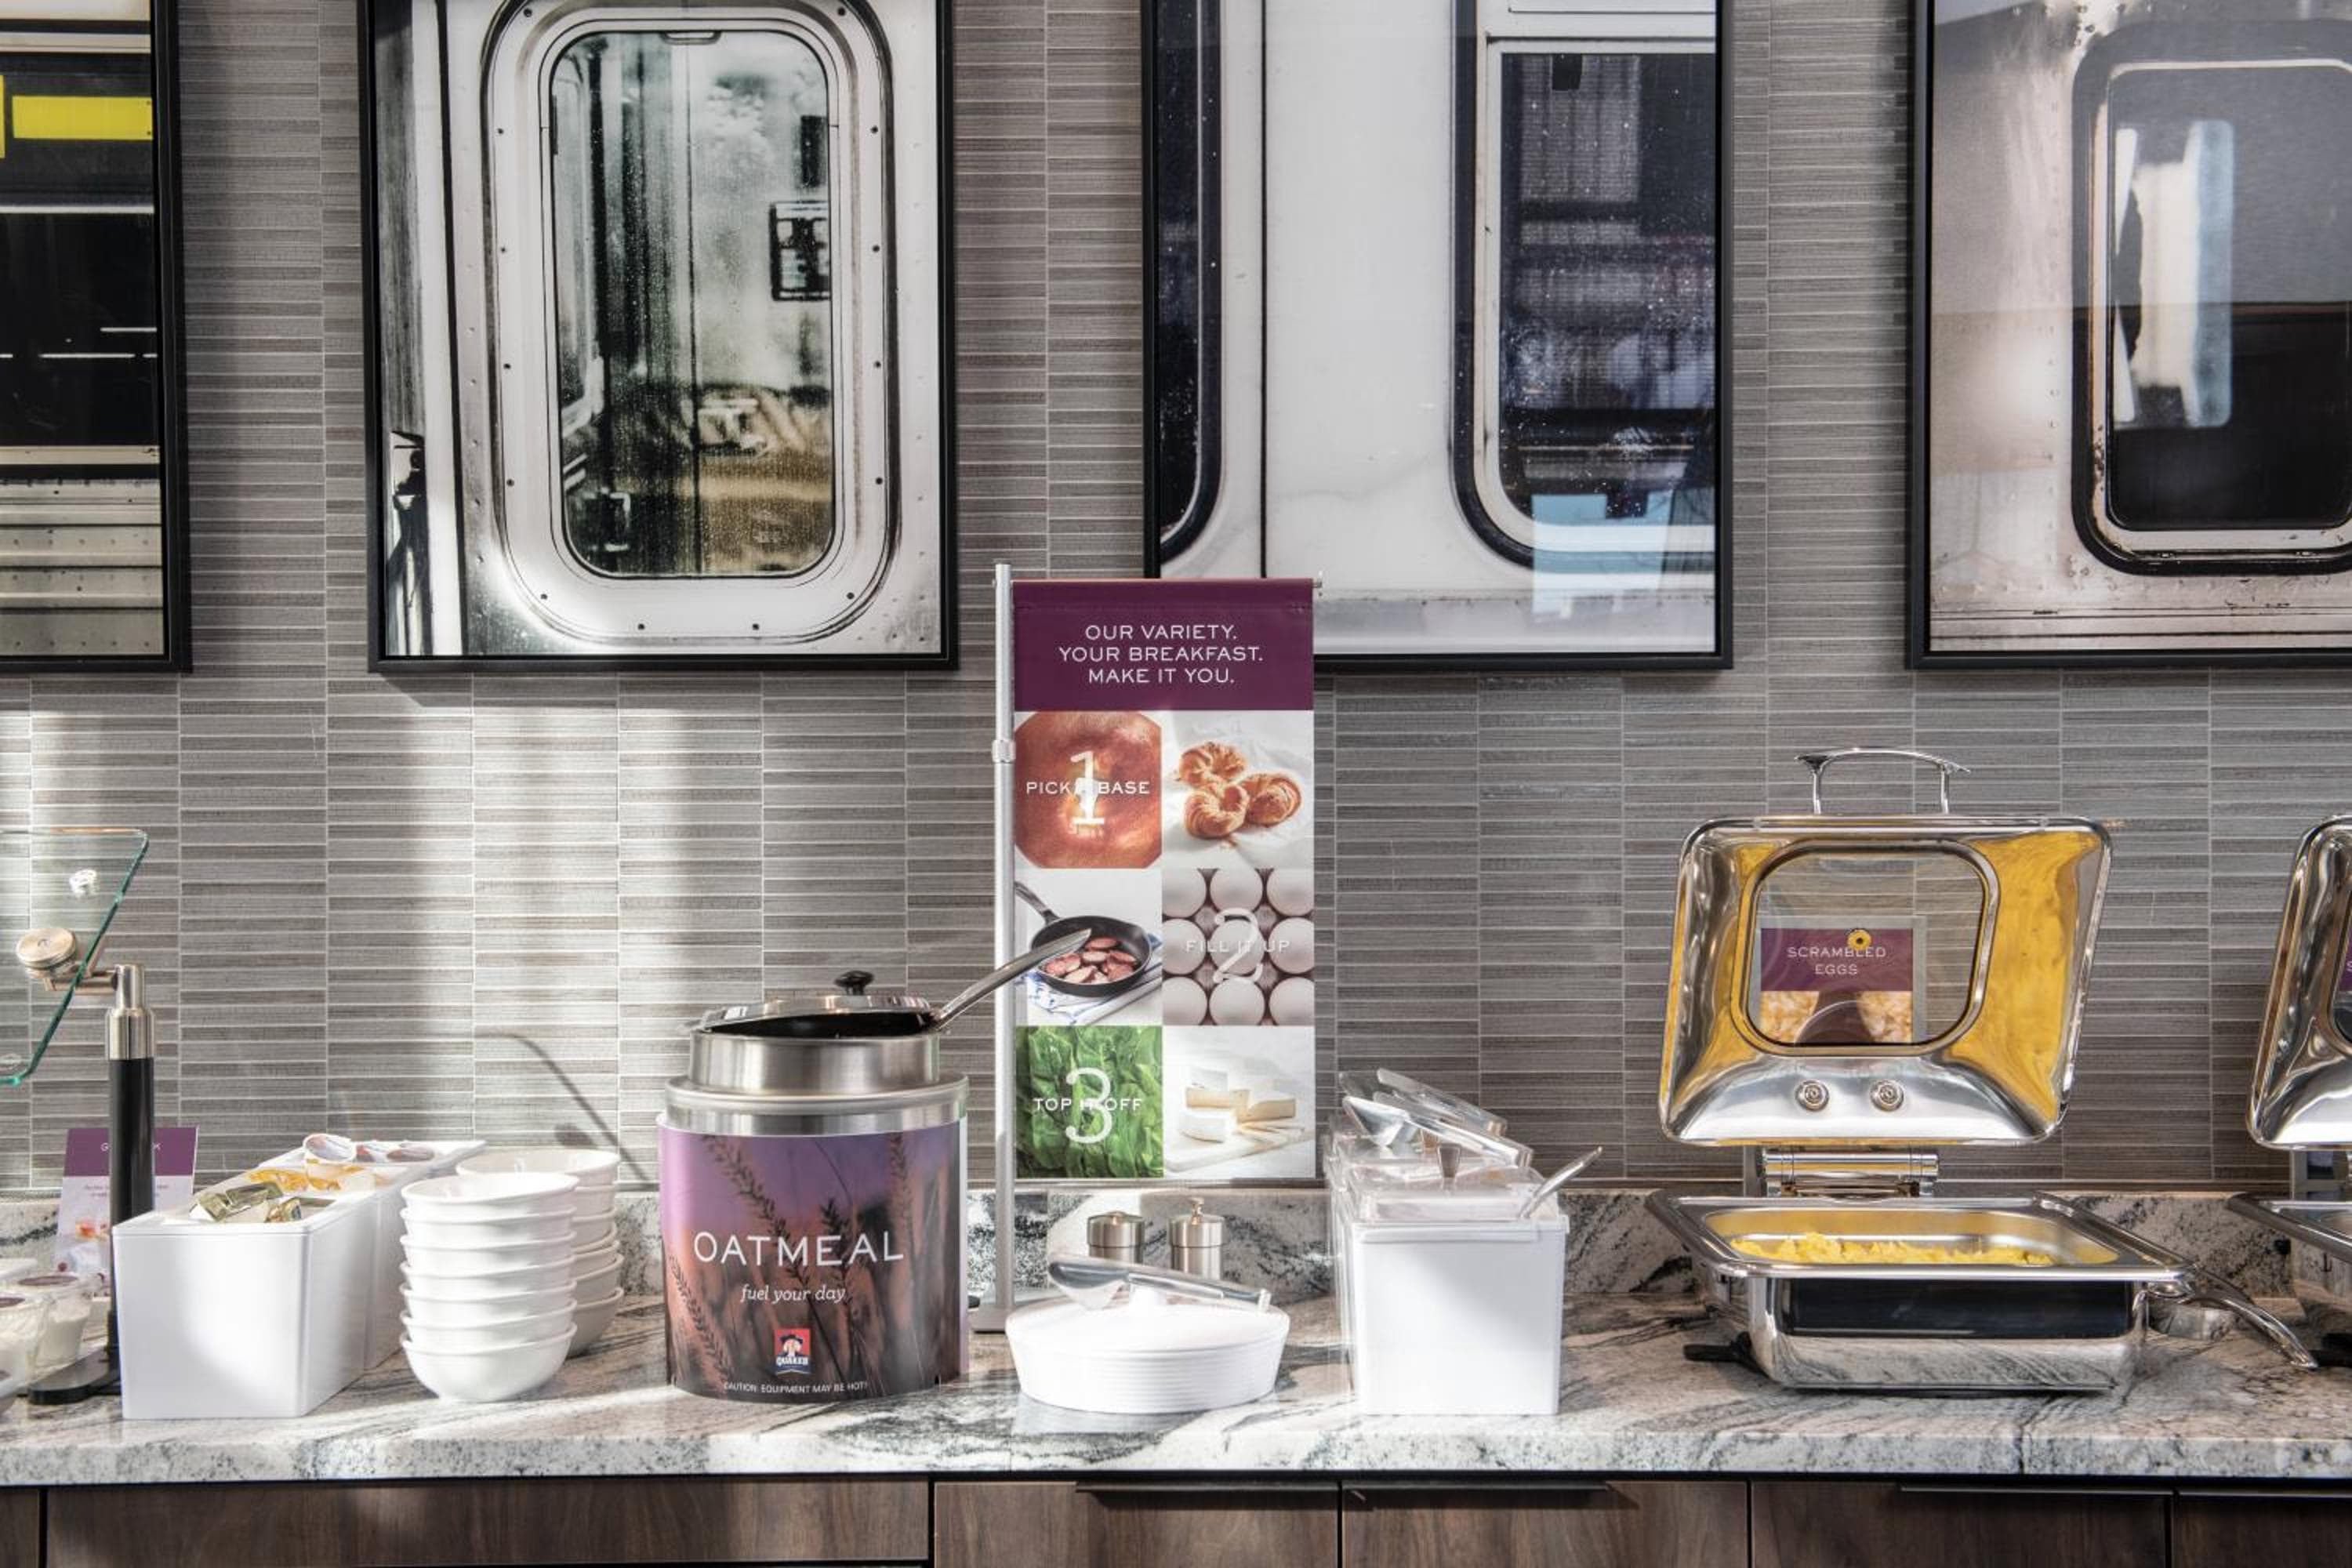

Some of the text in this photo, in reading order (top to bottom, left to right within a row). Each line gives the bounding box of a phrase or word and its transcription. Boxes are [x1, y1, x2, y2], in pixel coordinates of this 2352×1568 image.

[1085, 625, 1237, 640] OUR VARIETY.
[1059, 647, 1264, 662] YOUR BREAKFAST.
[1088, 668, 1235, 683] MAKE IT YOU.
[1026, 782, 1070, 794] PICK
[1098, 781, 1150, 795] BASE
[1070, 750, 1105, 825] 1
[1186, 940, 1230, 953] FILL
[1263, 940, 1290, 953] UP
[1213, 908, 1263, 983] 2
[1787, 946, 1886, 958] SCRAMBLED
[1815, 964, 1858, 975] EGGS
[1033, 1098, 1072, 1111] TOP
[1104, 1098, 1142, 1111] OFF
[1065, 1067, 1112, 1144] 3
[694, 1231, 904, 1266] OATMEAL
[740, 1283, 847, 1305] fuel your day
[760, 1384, 811, 1394] EQUIPMENT
[812, 1384, 833, 1393] MAY
[833, 1383, 846, 1392] BE
